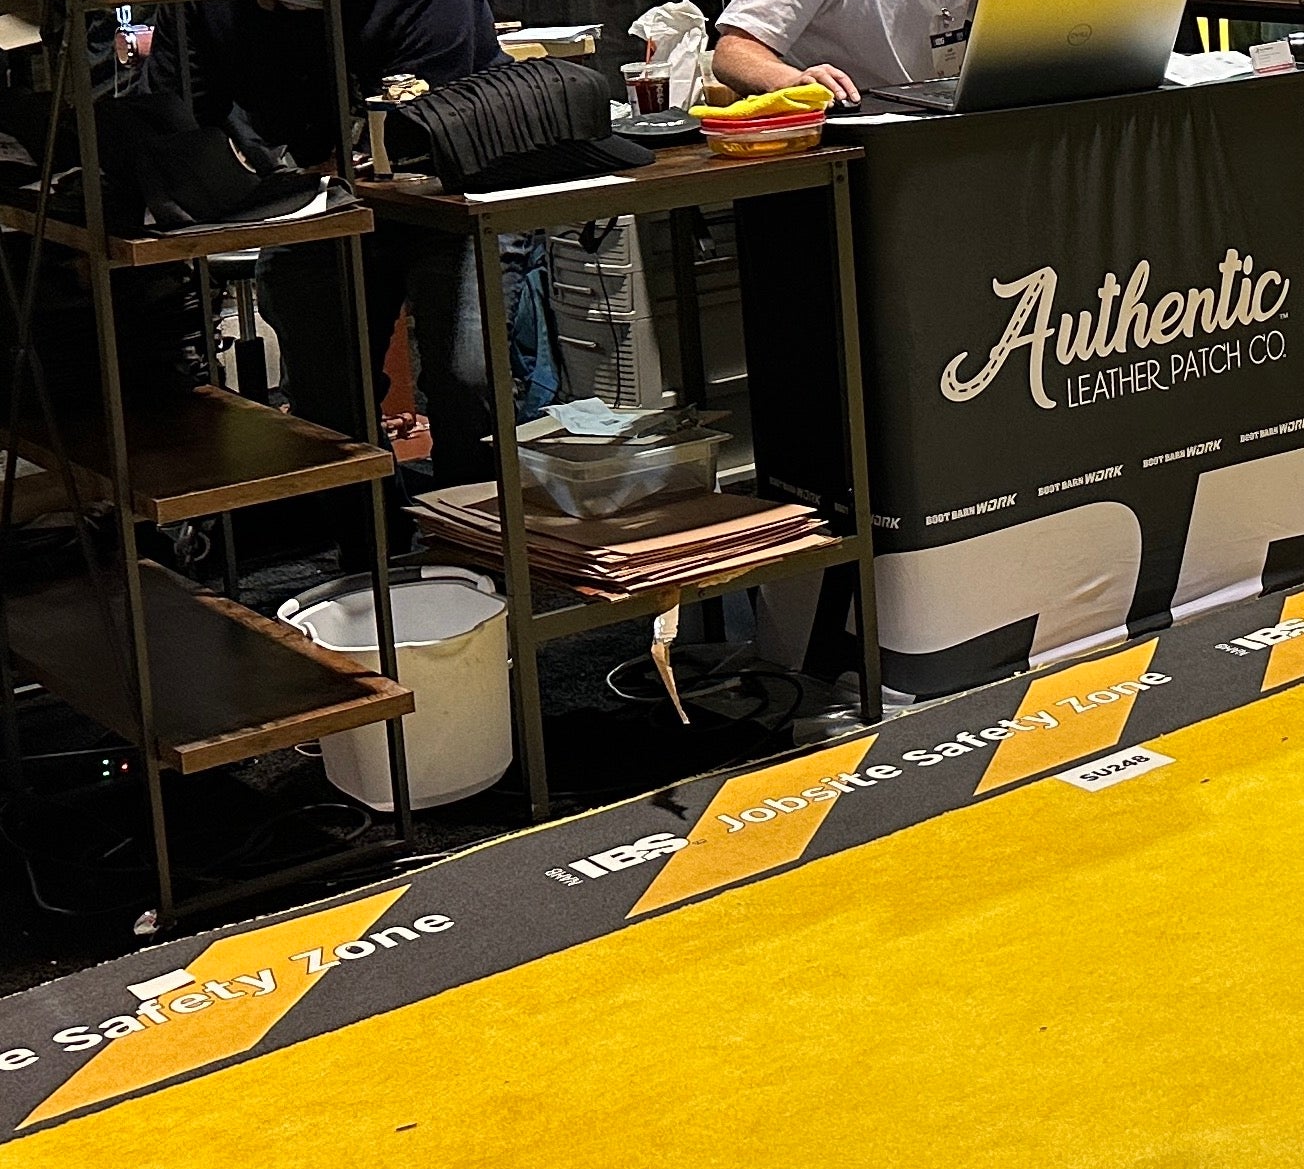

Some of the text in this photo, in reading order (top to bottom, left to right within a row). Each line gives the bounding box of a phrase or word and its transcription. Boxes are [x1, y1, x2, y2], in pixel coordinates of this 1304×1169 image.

[941, 248, 1290, 410] Authentic
[1067, 359, 1169, 408] LEATHER
[1171, 339, 1242, 385] PATCH
[1186, 438, 1223, 458] WORK
[1038, 482, 1061, 497] BOOT
[1084, 464, 1125, 485] WORK
[925, 511, 951, 526] BOOT
[975, 492, 1018, 515] WORK
[568, 832, 690, 880] IBS
[716, 762, 904, 835] Jobsite
[902, 708, 1061, 768] Safety
[1054, 668, 1174, 714] Zone
[1079, 755, 1150, 782] SU248
[52, 968, 278, 1052] Safety
[289, 913, 456, 975] Zone
